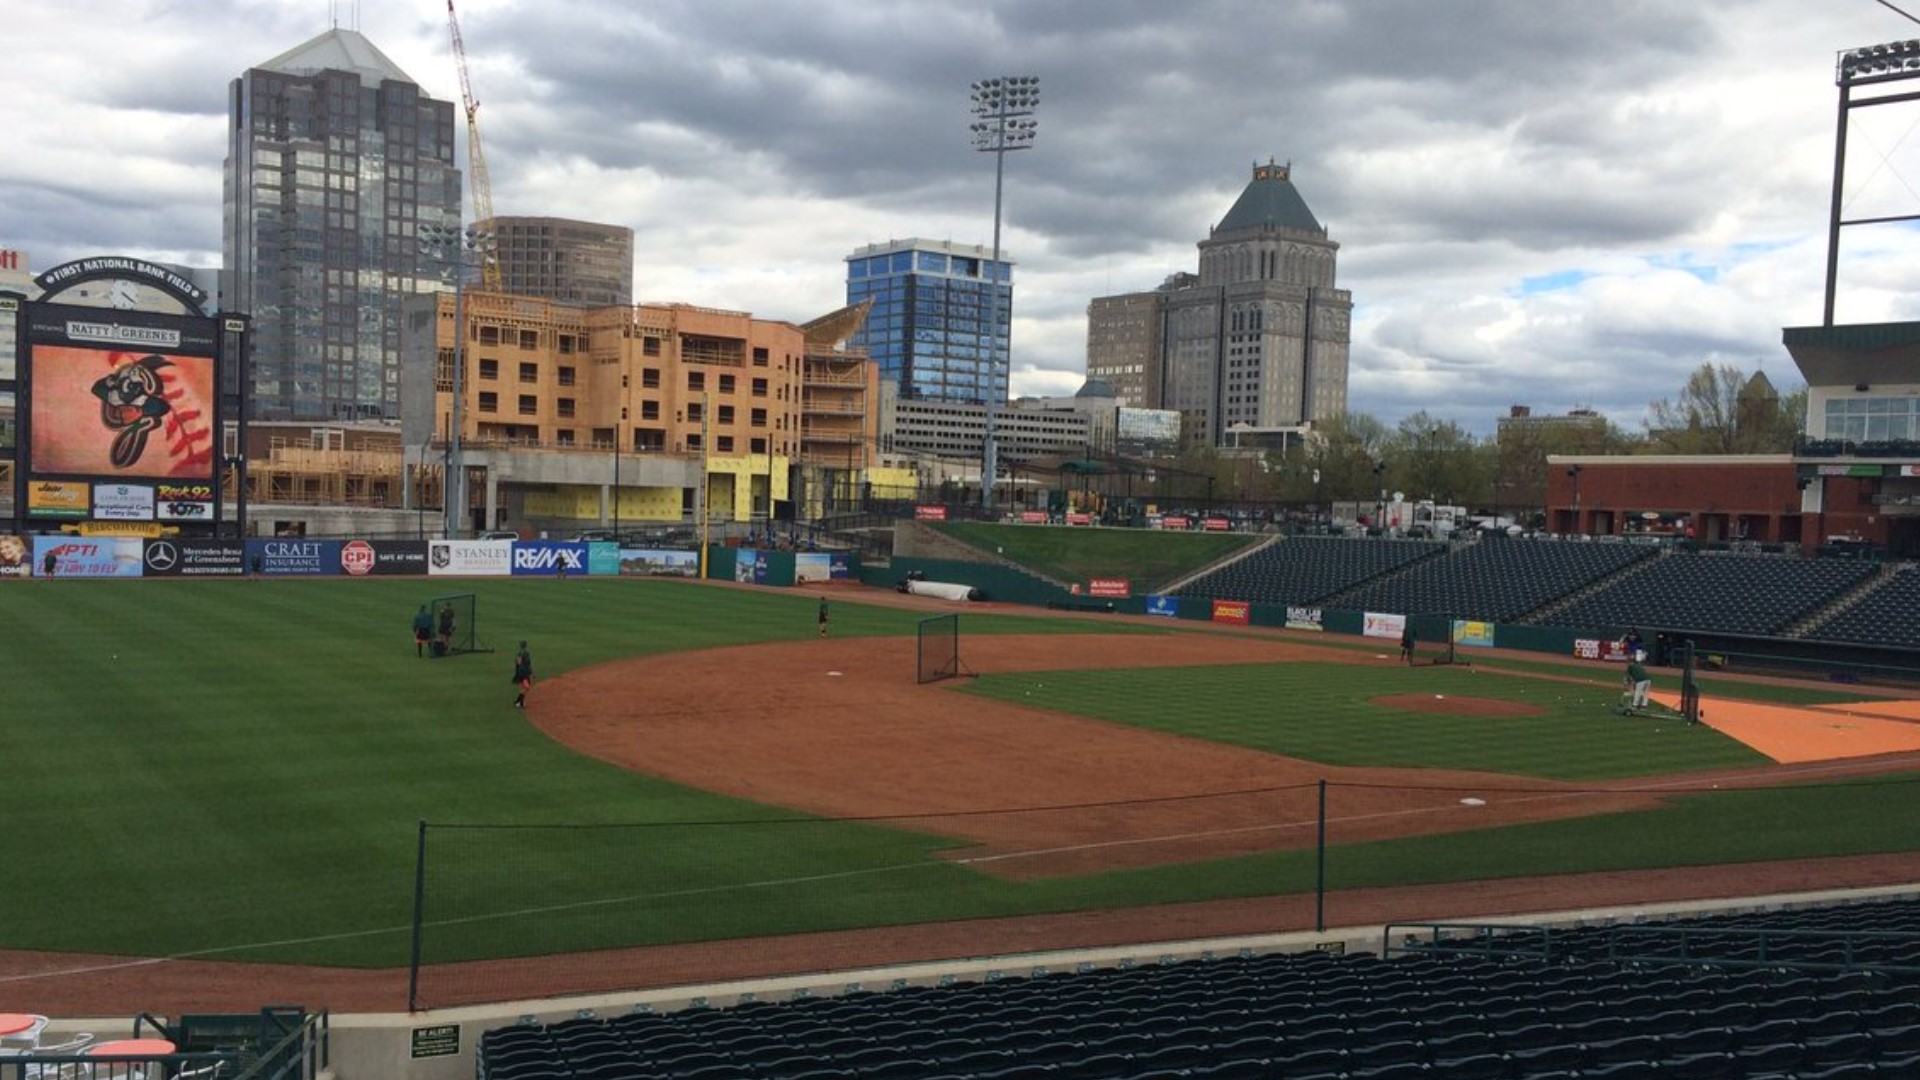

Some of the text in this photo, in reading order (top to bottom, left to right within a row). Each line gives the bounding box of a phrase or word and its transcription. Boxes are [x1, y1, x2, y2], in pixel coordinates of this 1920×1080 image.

[0, 251, 18, 270] tt
[53, 258, 193, 294] FIRST NATIONAL BANK FIELD
[71, 323, 110, 336] NATTY
[192, 486, 213, 500] 92
[88, 522, 156, 533] Biscuitville
[63, 543, 98, 556] PTI
[264, 543, 322, 556] CRAFT
[455, 548, 508, 558] STANLEY
[265, 558, 320, 567] INSURANCE
[345, 552, 371, 563] CPI
[379, 553, 424, 561] SAFE AT HOME
